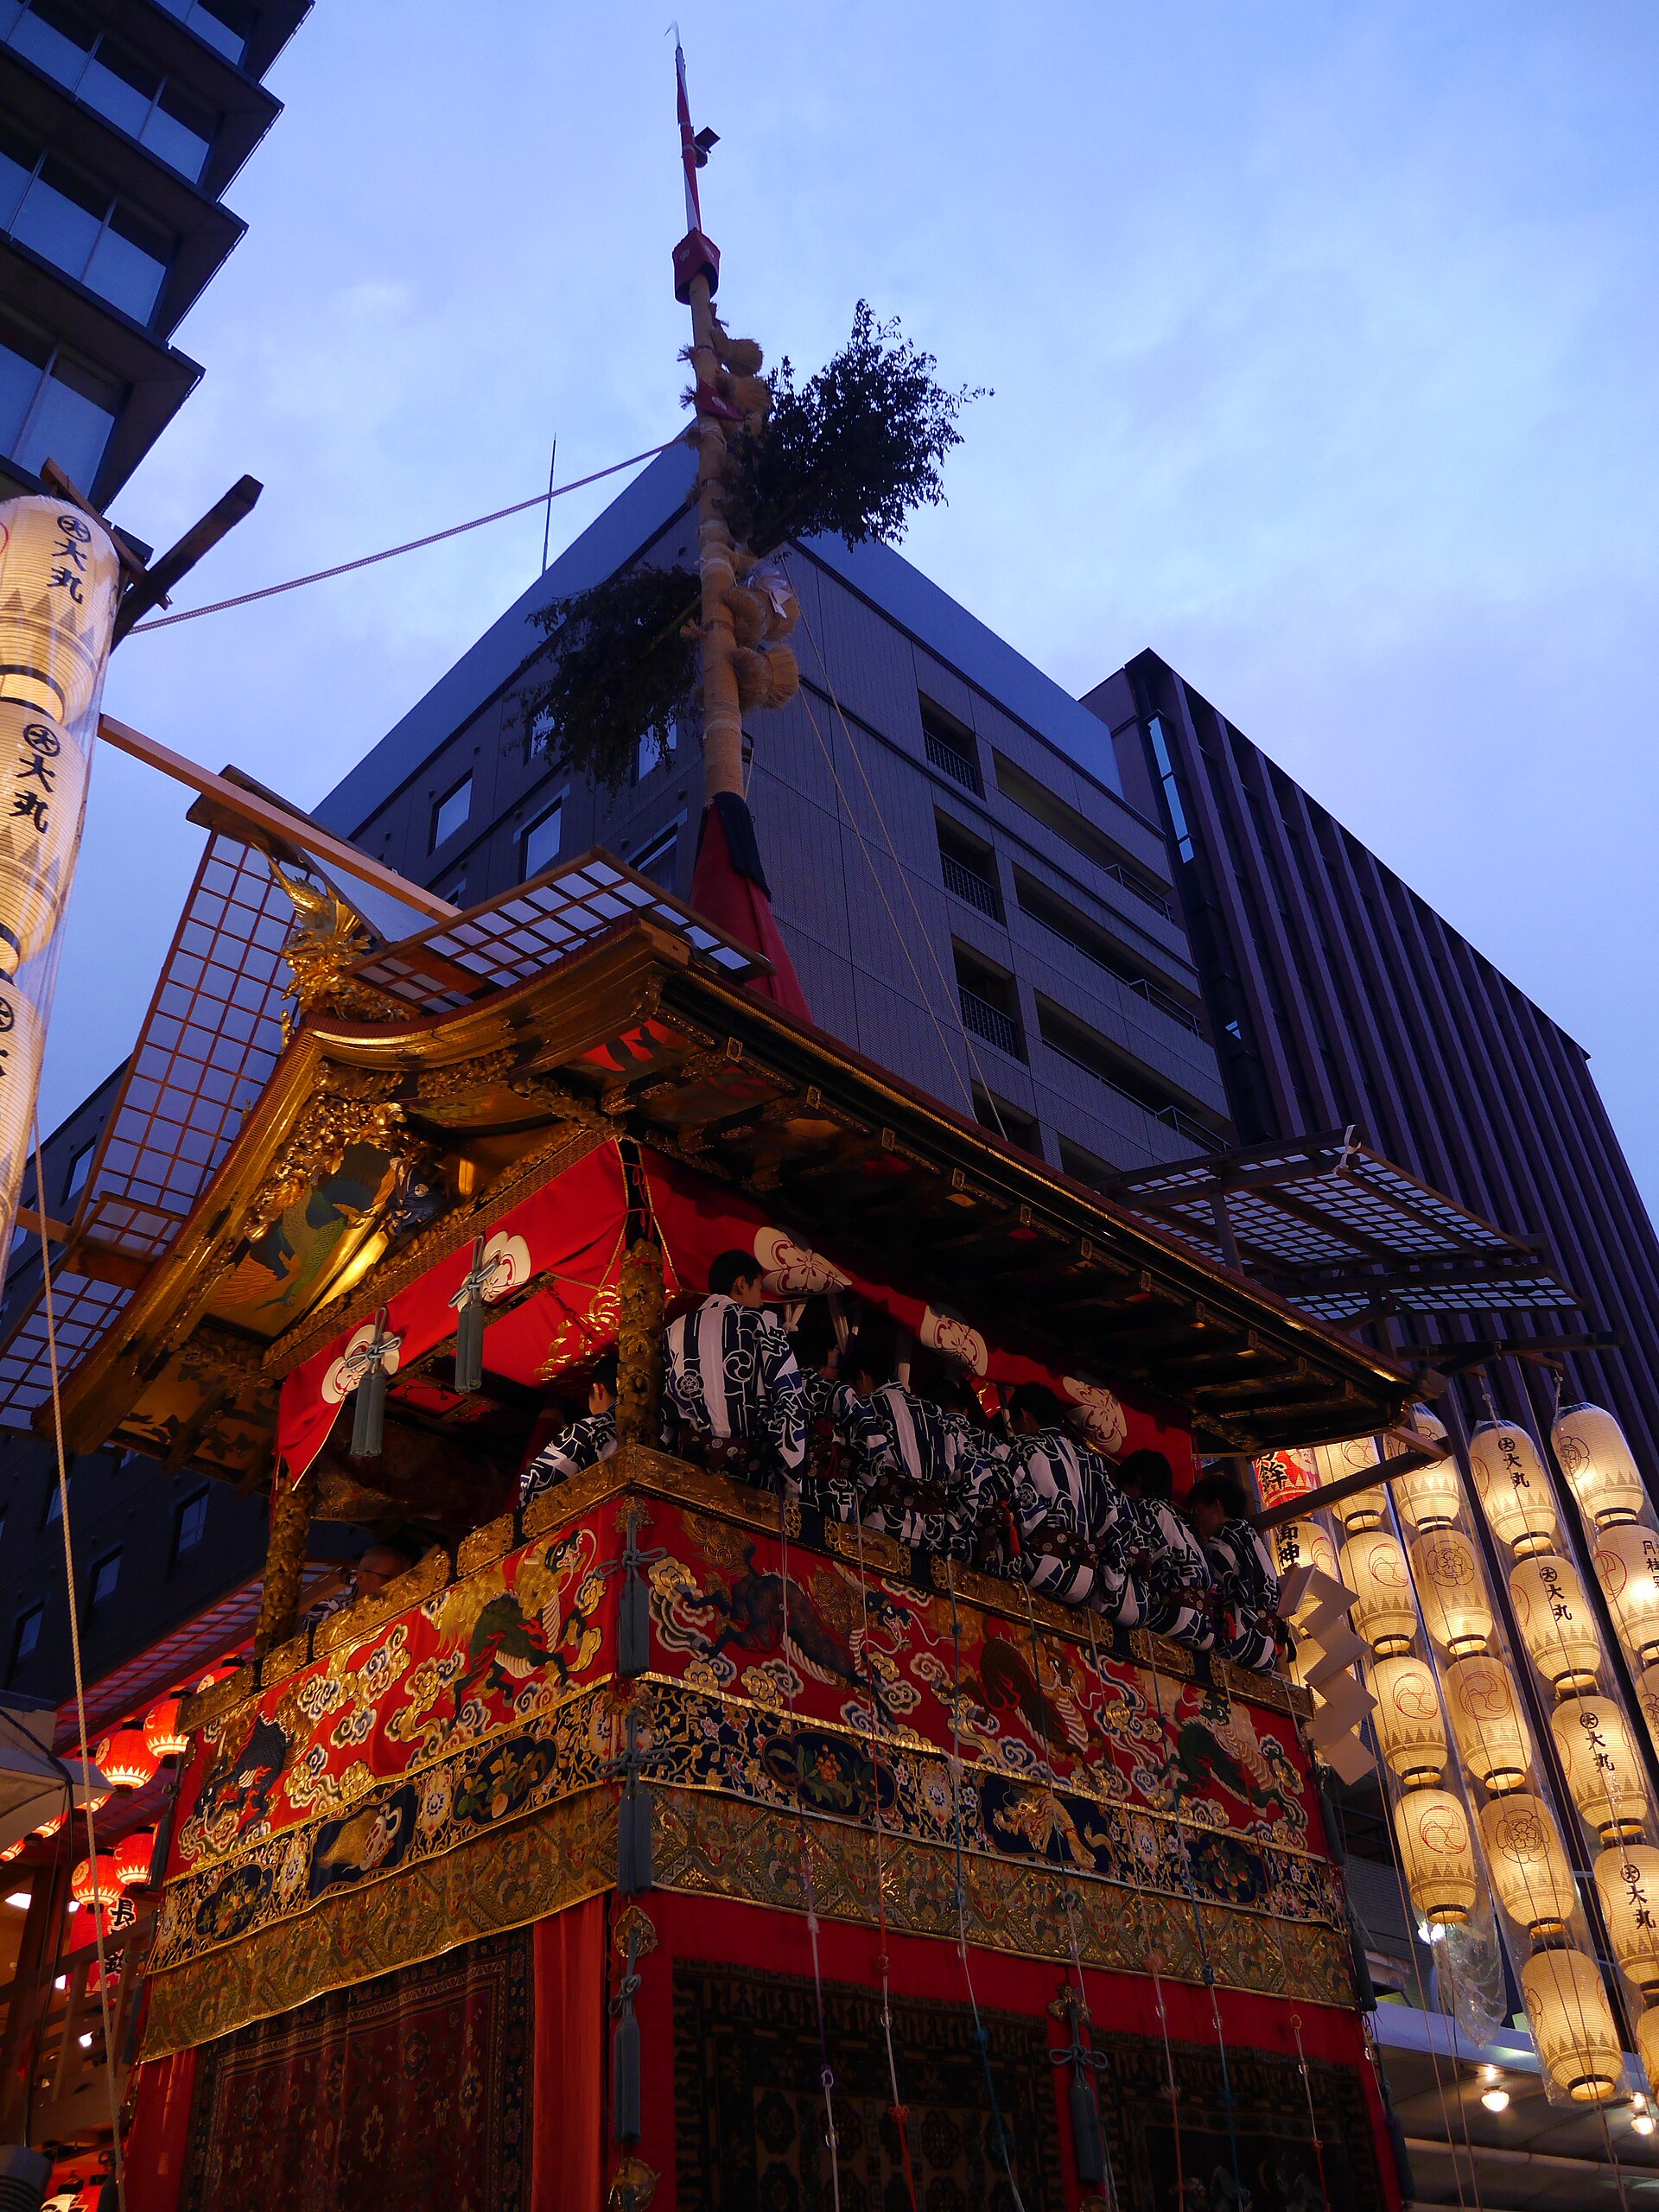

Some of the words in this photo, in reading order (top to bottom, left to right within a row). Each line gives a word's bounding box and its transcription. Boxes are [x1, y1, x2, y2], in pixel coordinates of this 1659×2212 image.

[47, 538, 87, 605] 大丸
[9, 753, 56, 834] 大丸
[1503, 1453, 1530, 1490] 大丸
[1548, 1584, 1573, 1621] 大丸
[1585, 1731, 1614, 1772] 大丸
[1626, 1885, 1656, 1930] 大丸
